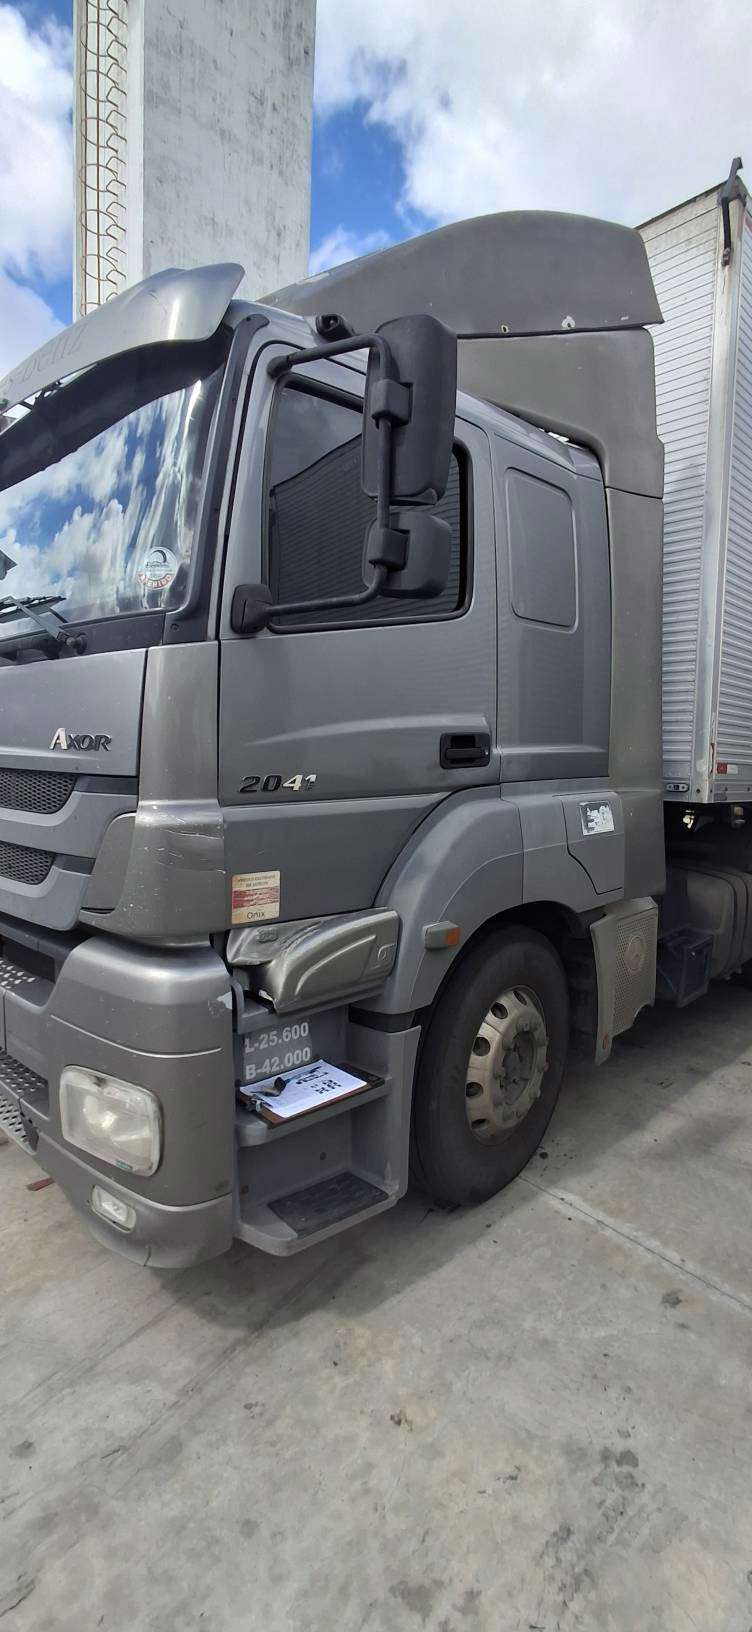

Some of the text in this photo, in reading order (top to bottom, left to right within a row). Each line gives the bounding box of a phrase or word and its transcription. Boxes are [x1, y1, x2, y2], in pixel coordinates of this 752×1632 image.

[239, 774, 317, 793] 2041
[245, 1022, 309, 1053] L-25.600
[245, 1047, 311, 1080] B-42.000
